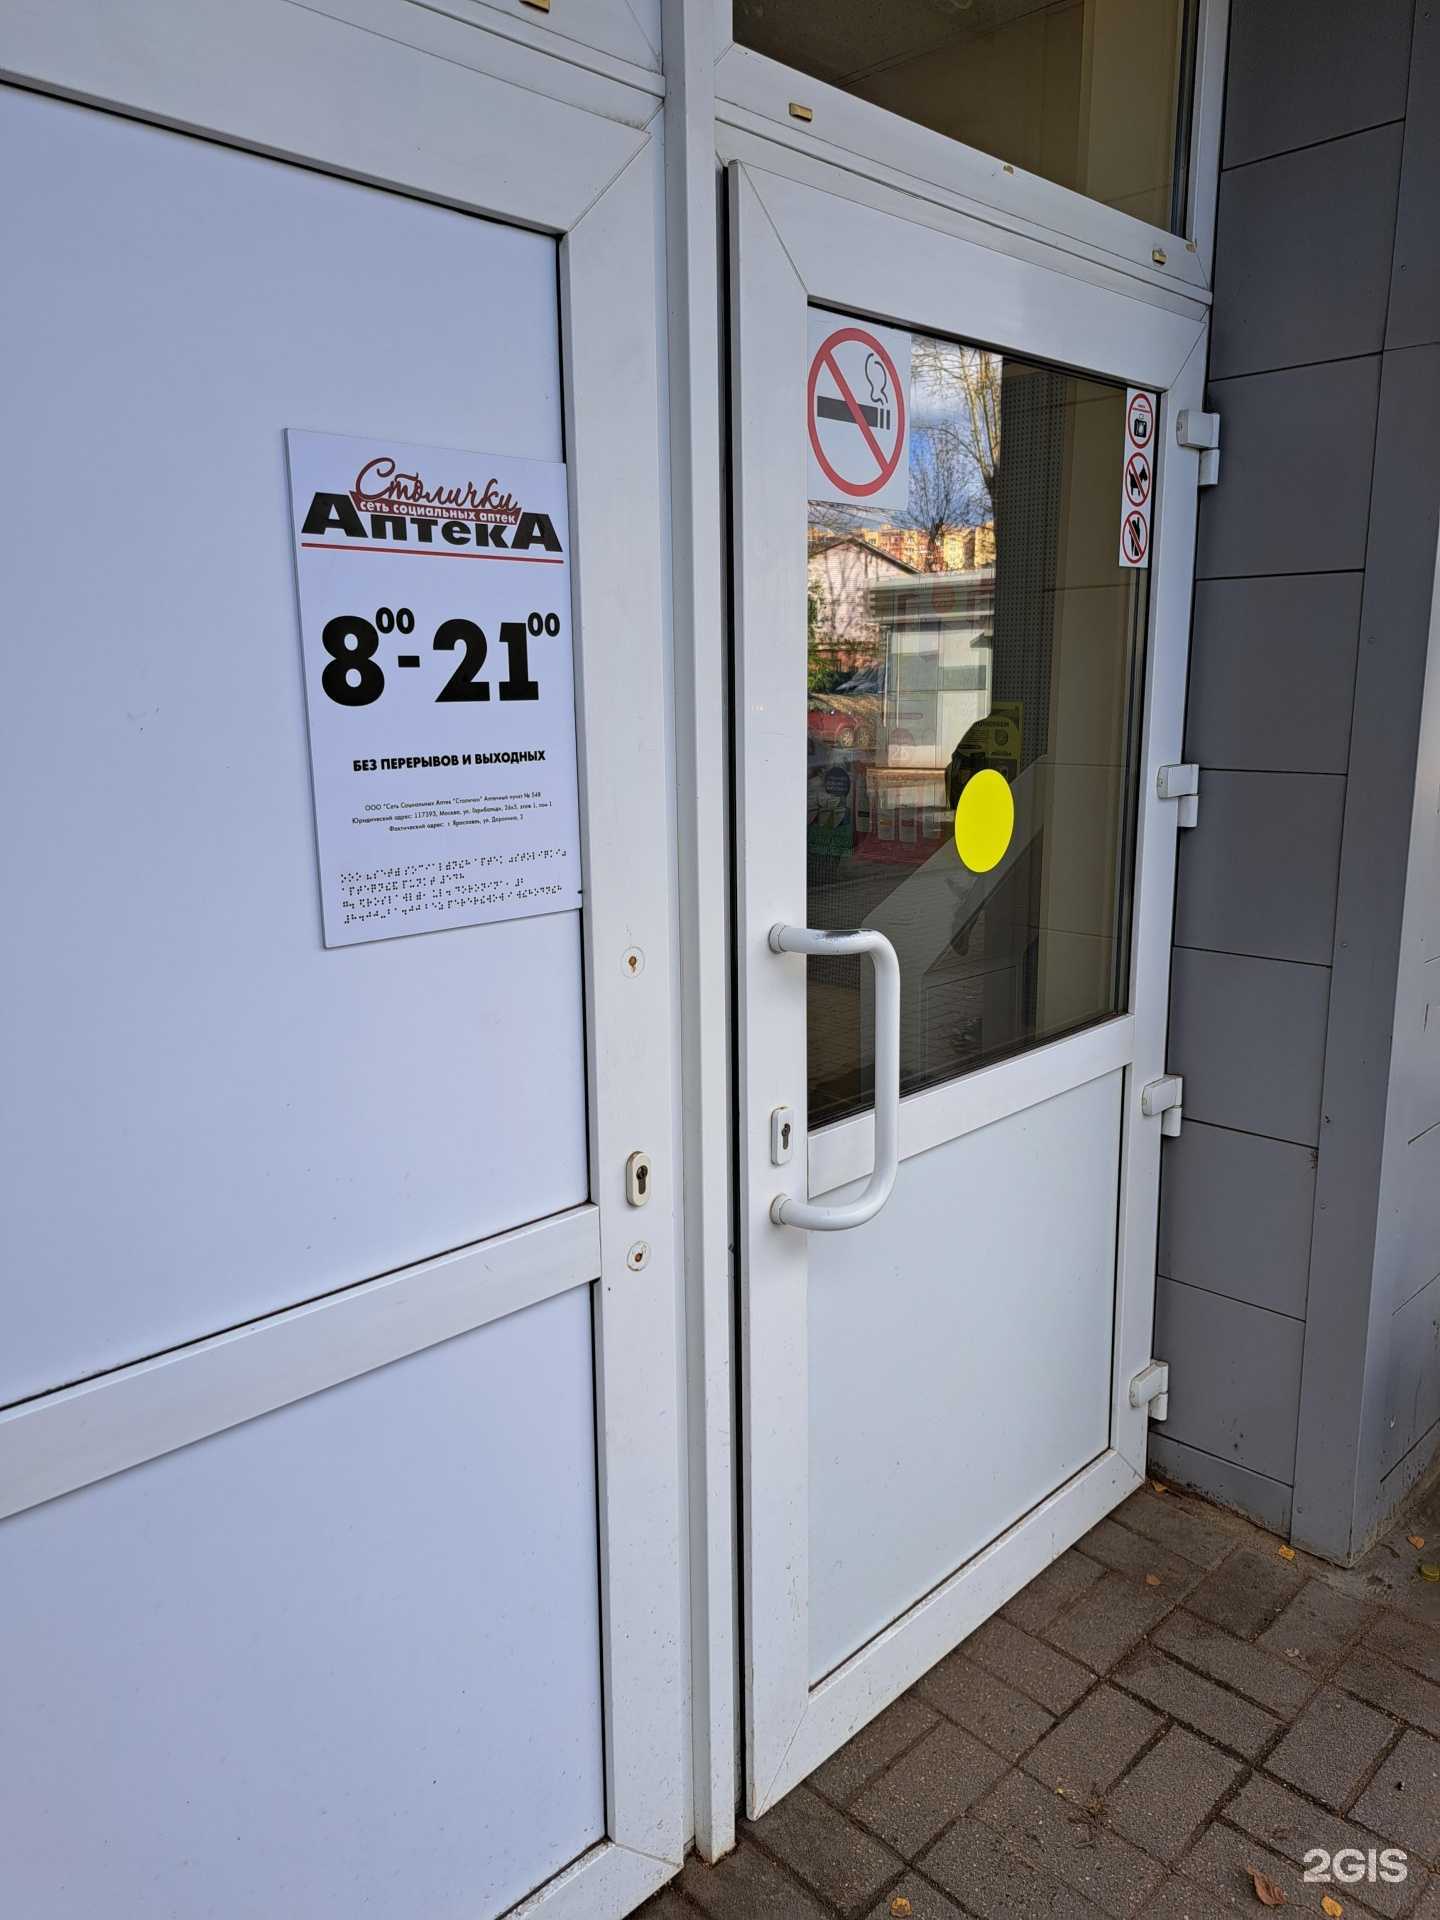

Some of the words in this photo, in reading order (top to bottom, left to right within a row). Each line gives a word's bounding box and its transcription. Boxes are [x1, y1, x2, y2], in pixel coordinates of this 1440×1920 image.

[355, 457, 518, 512] Столички
[360, 500, 390, 513] сеть
[393, 503, 476, 521] социальных
[479, 511, 516, 524] аптек
[352, 759, 378, 772] БЕЗ
[380, 754, 460, 770] ПЕРЕРЫВОВ
[462, 754, 472, 766] И
[474, 750, 546, 766] ВЫХОДНЫХ
